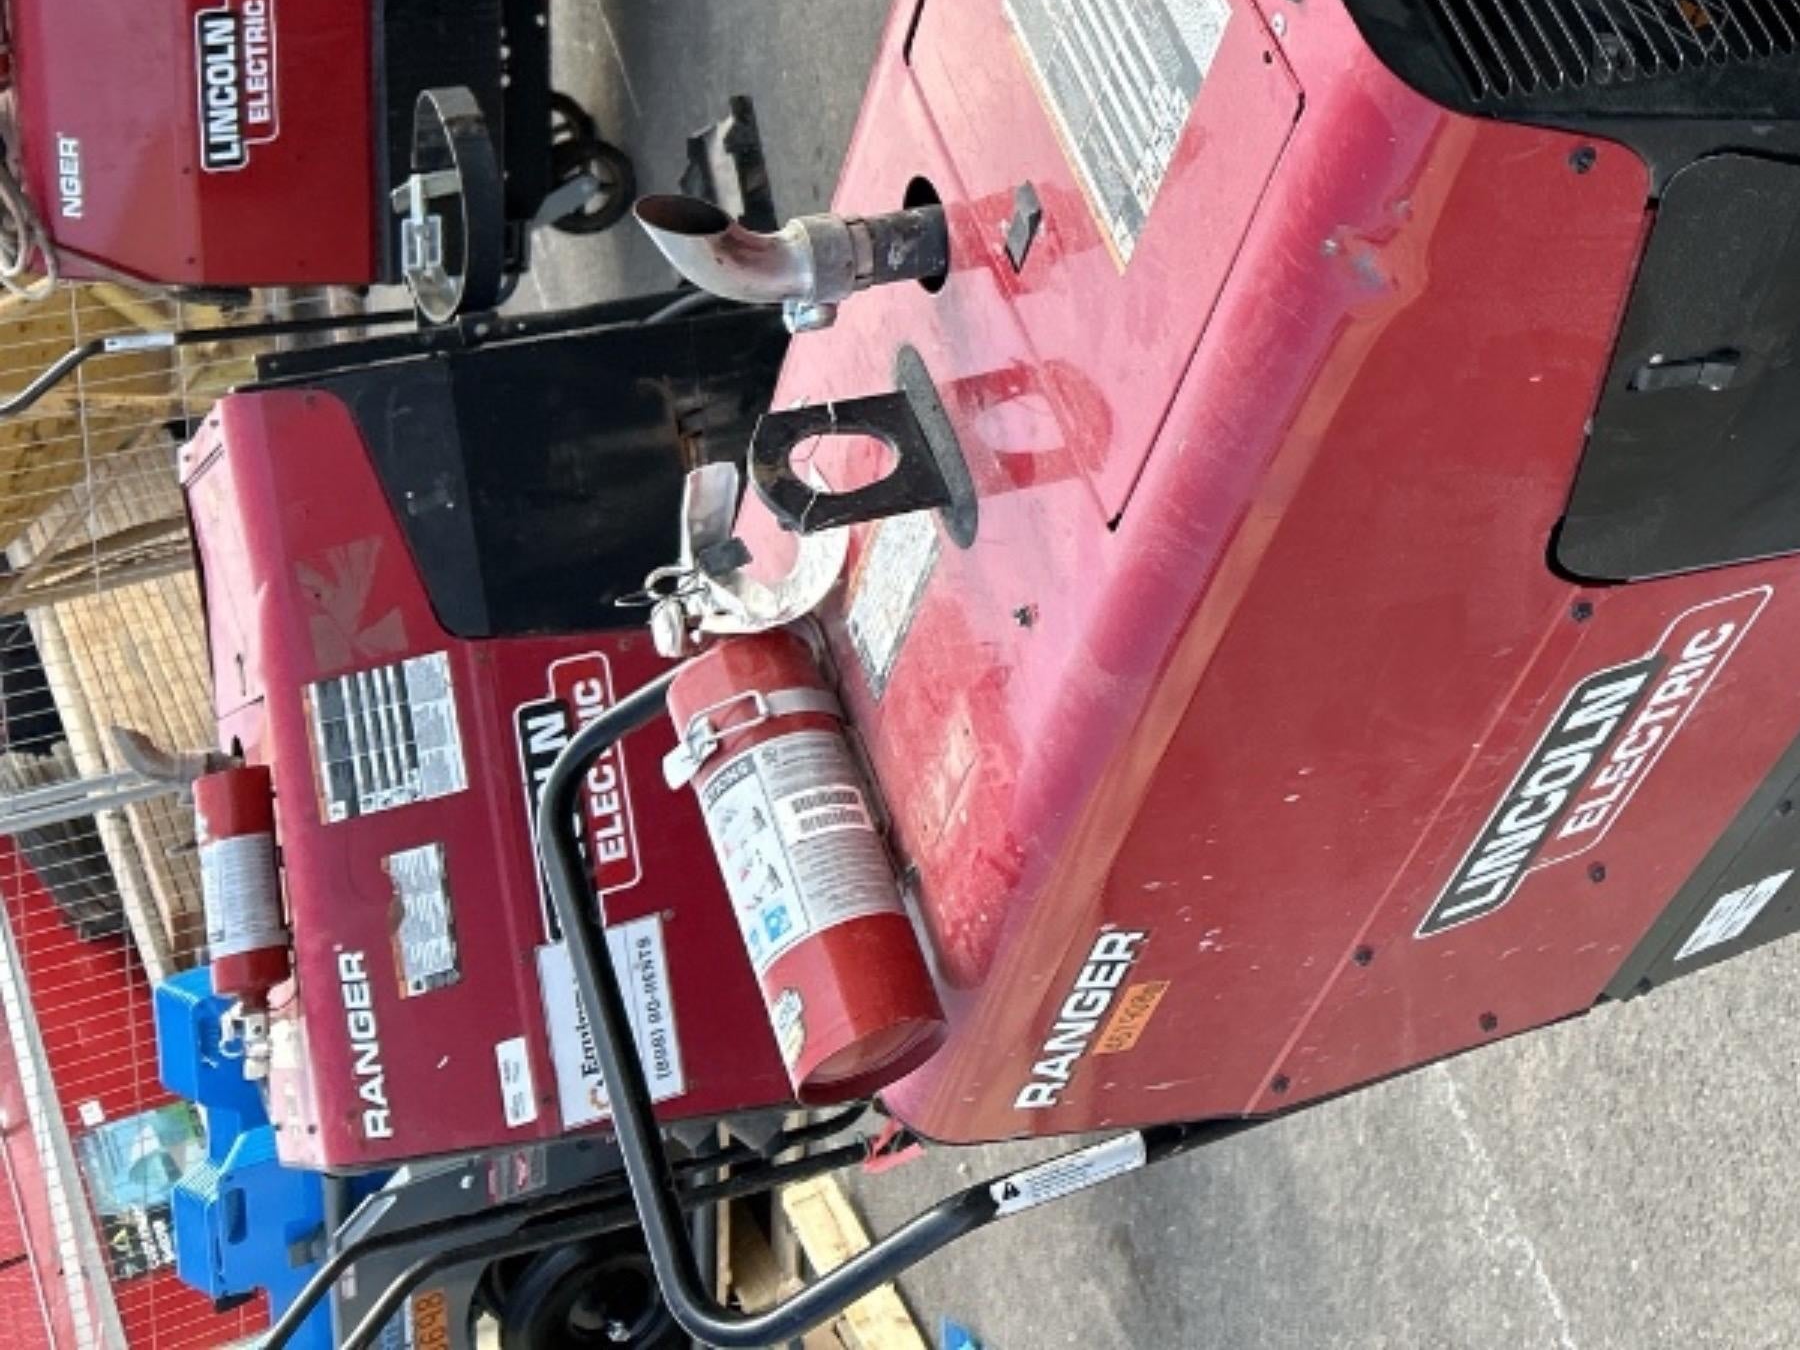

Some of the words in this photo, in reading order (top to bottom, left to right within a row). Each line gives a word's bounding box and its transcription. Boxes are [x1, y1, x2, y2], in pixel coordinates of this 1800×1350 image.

[203, 17, 241, 161] LINCOLN
[243, 0, 271, 123] ELECTRIC
[573, 677, 628, 864] ELECIC
[1438, 672, 1649, 919] LINCOLN
[1555, 621, 1736, 838] ELECTRIC
[337, 951, 394, 1138] RANGER
[1013, 931, 1145, 1109] RANGER
